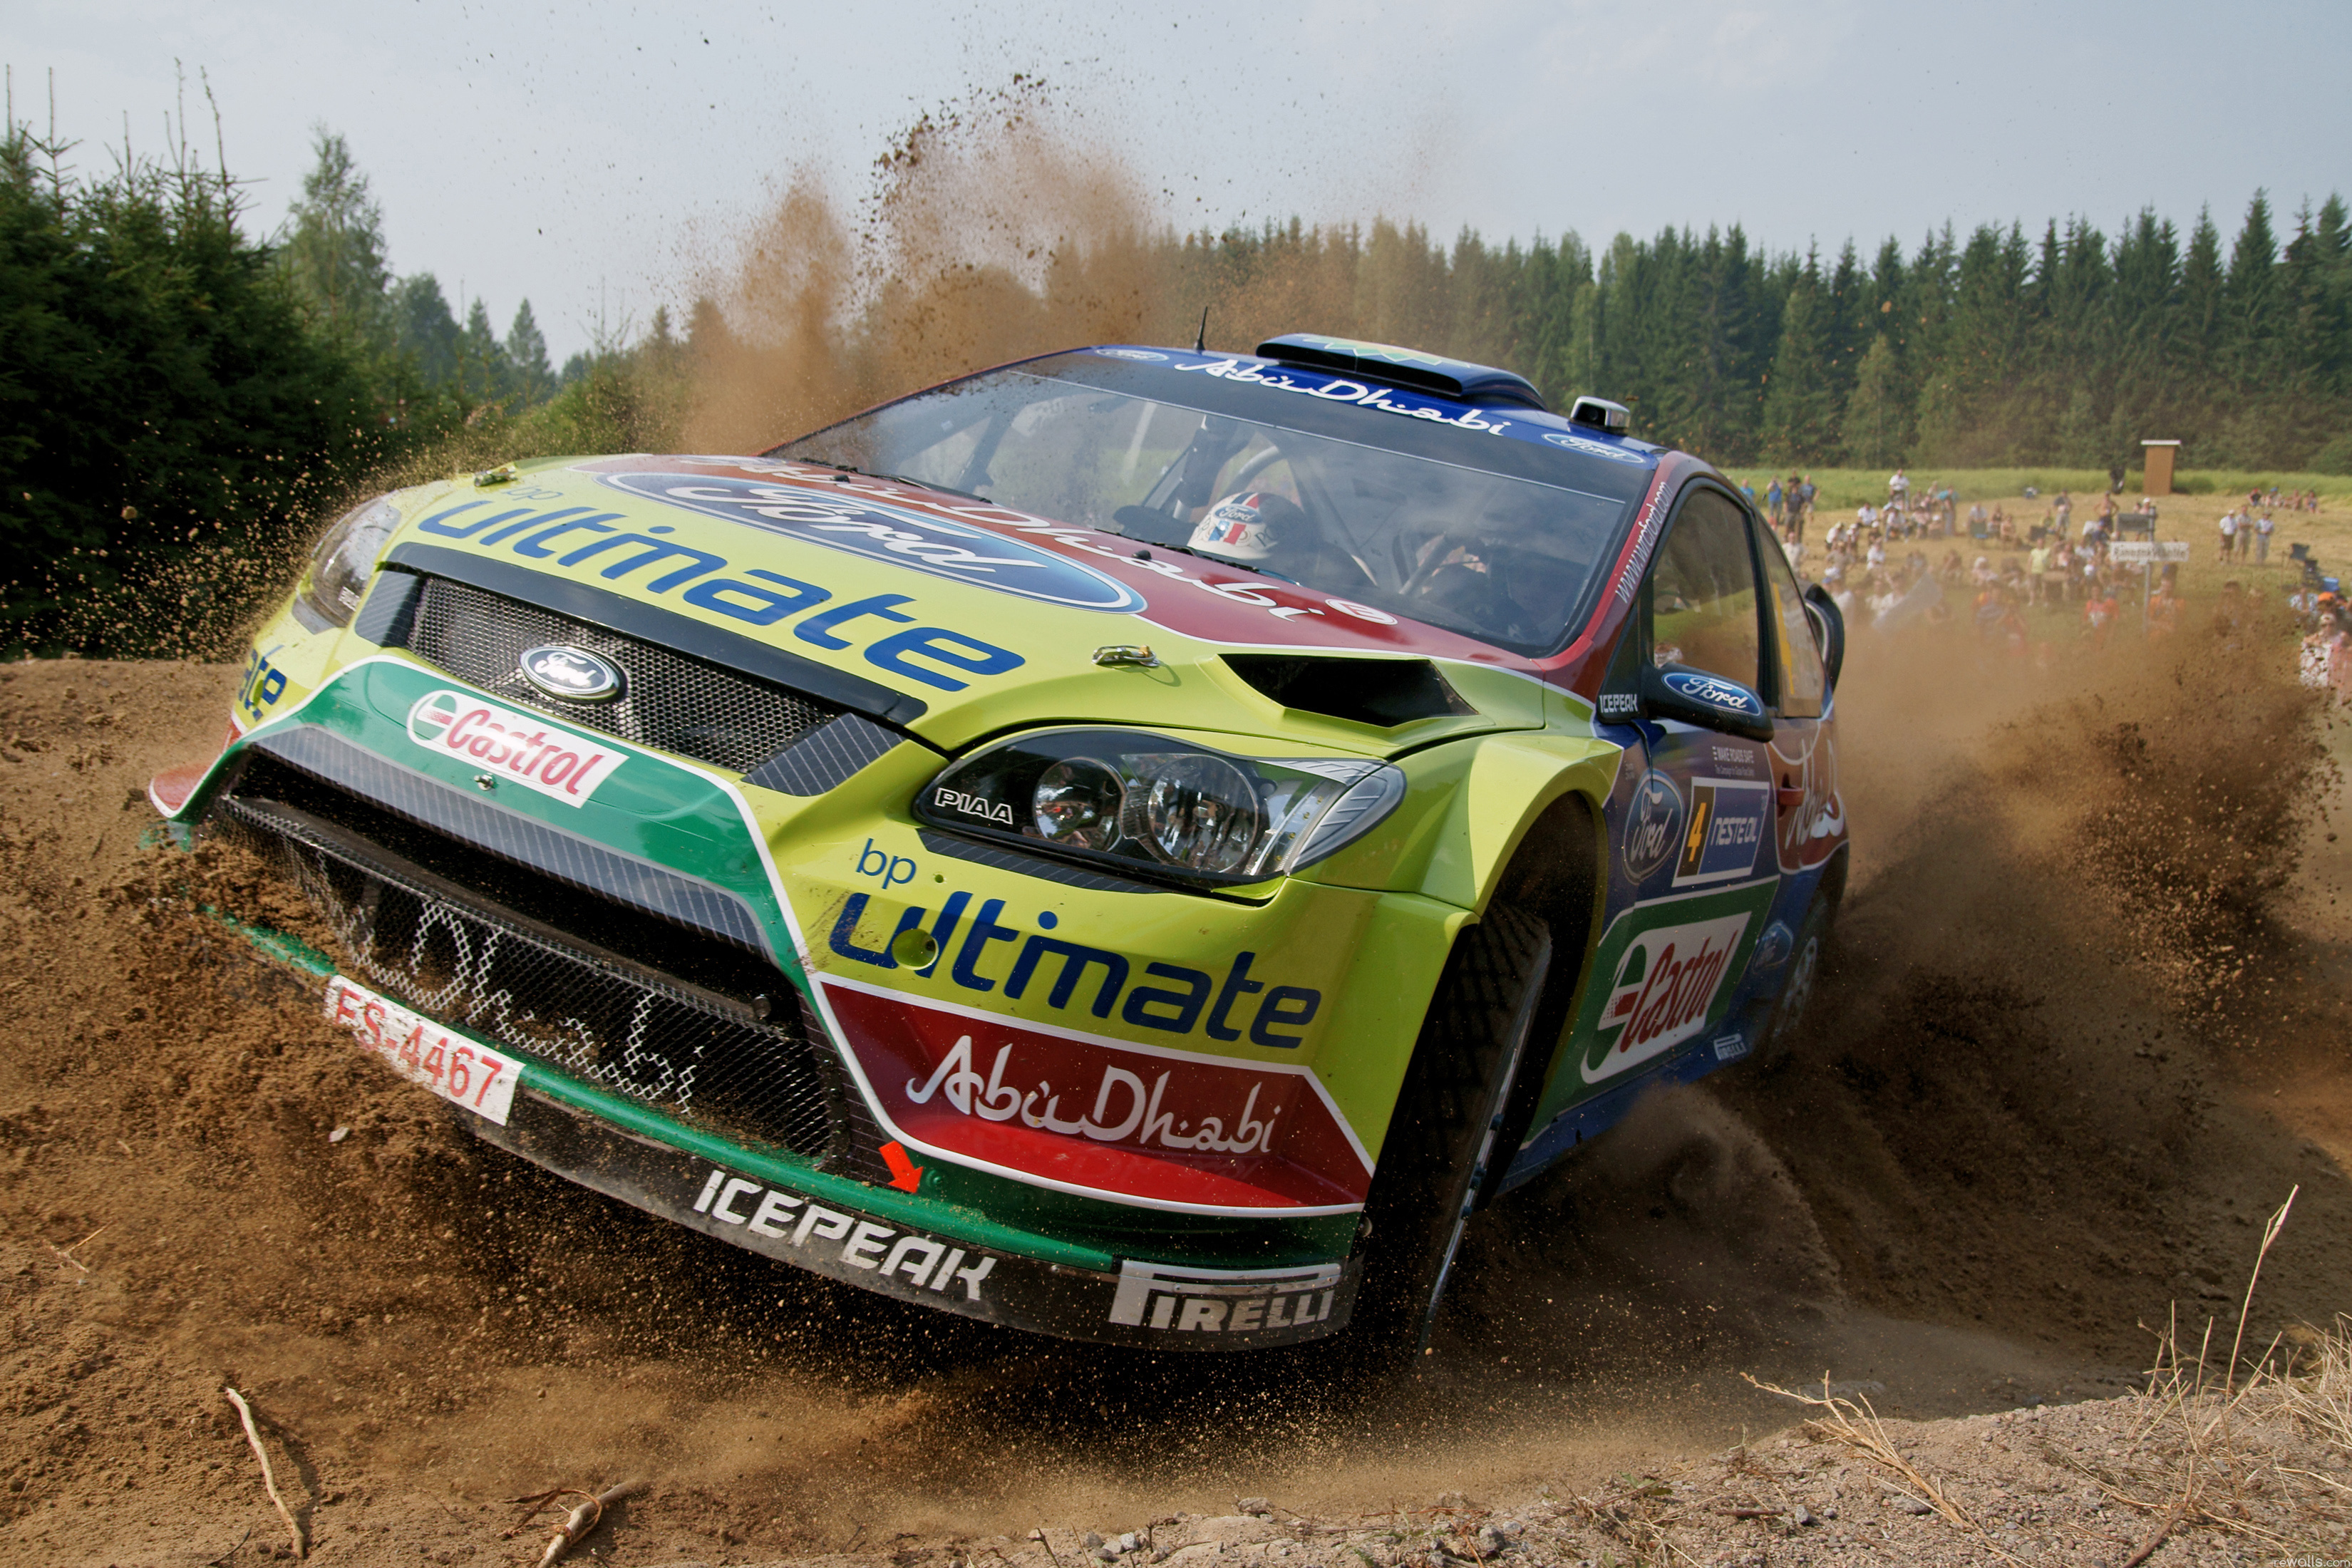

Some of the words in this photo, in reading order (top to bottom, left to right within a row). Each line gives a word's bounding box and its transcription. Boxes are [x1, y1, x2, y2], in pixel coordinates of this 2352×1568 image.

[1174, 359, 1313, 393] Abu
[1309, 379, 1512, 436] Dhabi
[1560, 438, 1627, 458] Ford
[502, 485, 564, 501] bp
[1219, 505, 1256, 522] Ford
[665, 487, 1048, 573] Ford
[937, 503, 1326, 623] Dhabi
[418, 500, 1026, 692] ultimate
[534, 651, 597, 687] Ford
[1599, 693, 1639, 713] ICEPEAK
[1682, 677, 1749, 708] Ford
[446, 709, 606, 795] Castrol
[934, 788, 1013, 825] PIAA
[1686, 803, 1707, 862] 4
[857, 838, 917, 889] bp
[828, 891, 1321, 1048] ultimate
[1619, 929, 1738, 1053] Castrol
[906, 1036, 1080, 1133] Abu
[1076, 1065, 1281, 1155] Dhabi
[693, 1170, 997, 1301] ICEPEAK
[1109, 1259, 1341, 1332] PIRELLI
